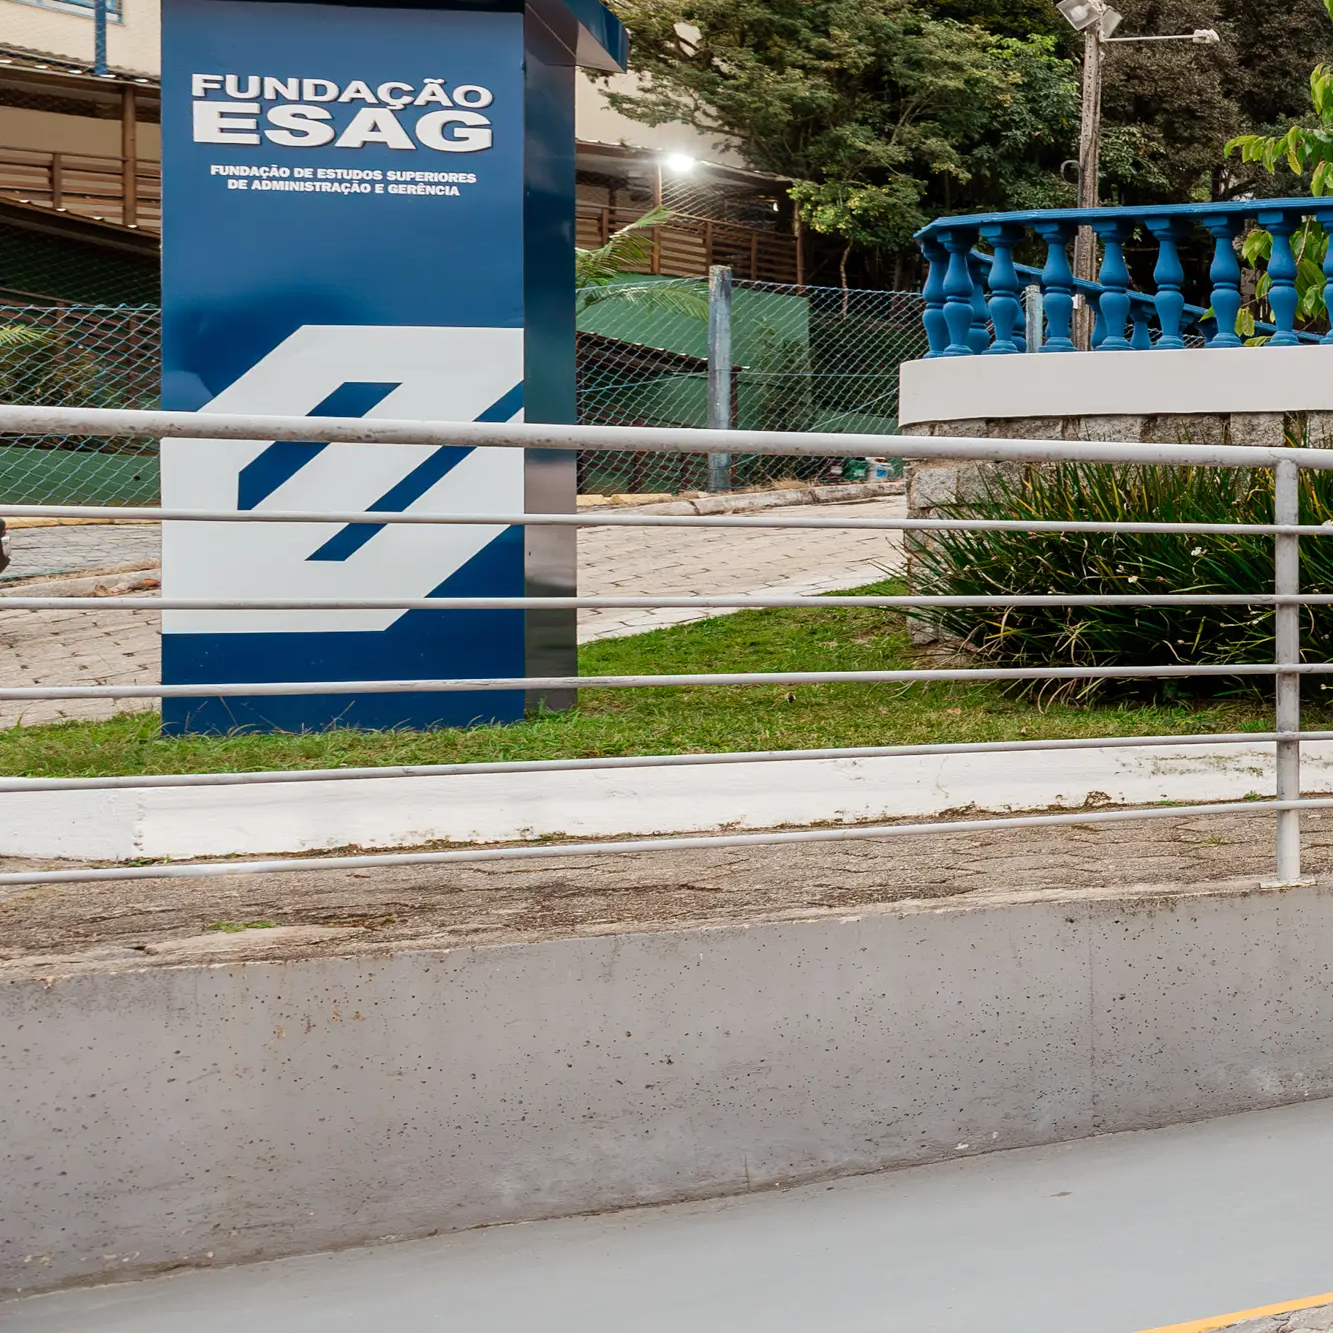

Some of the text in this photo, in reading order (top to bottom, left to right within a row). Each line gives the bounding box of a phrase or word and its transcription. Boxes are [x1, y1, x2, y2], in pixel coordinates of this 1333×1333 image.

[191, 73, 494, 110] FUNDAÇÃO
[192, 101, 494, 153] ESAG
[210, 164, 477, 183] FUNDAÇÃO DE ESTUDOS SUPERIORES
[227, 179, 460, 196] DE ADMINISTRAÇÃO E GERÊNCIA
